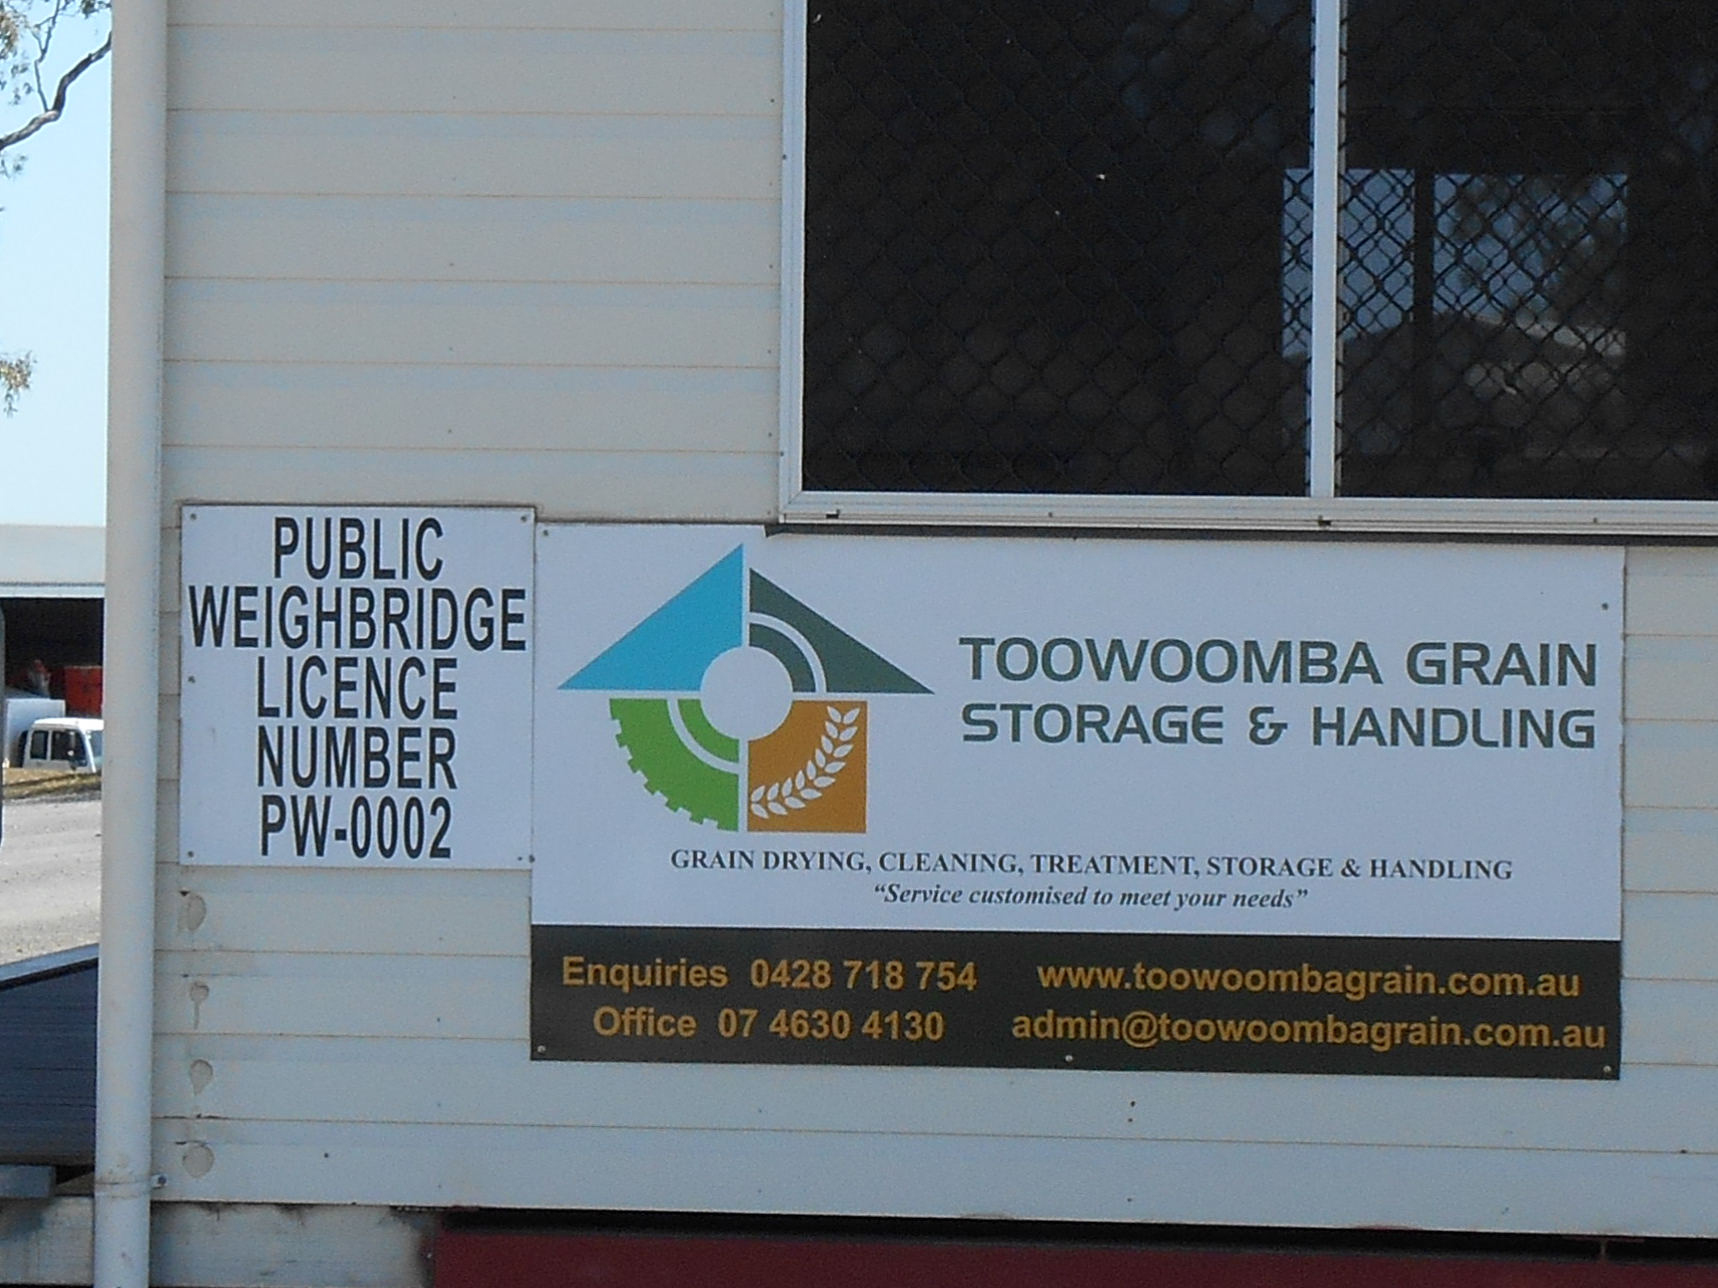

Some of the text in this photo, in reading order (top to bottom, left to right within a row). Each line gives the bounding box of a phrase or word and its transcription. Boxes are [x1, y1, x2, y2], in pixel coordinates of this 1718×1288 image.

[273, 517, 444, 580] PUBLIC
[189, 585, 526, 651] WEIGHBRIDGE
[959, 637, 1597, 687] TOOWOOMBA GRAIN
[256, 655, 458, 720] LICENCE
[962, 703, 1596, 749] STORAGE & HANDLING
[257, 726, 458, 790] NUMBER
[260, 794, 452, 859] PW-0002
[671, 849, 1513, 881] GRAIN DRYING, CLEANING, TREATMENT, STORAGE & HANDLING
[874, 883, 1308, 911] “Service customised to meet your needs”
[562, 956, 977, 993] Enquiries 0428 718 754
[1037, 961, 1581, 1001] www.toowoombagrain.com.au
[593, 1006, 944, 1041] Office 07 4630 4130
[1012, 1009, 1606, 1052] admin@toowoombagrain.com.au
